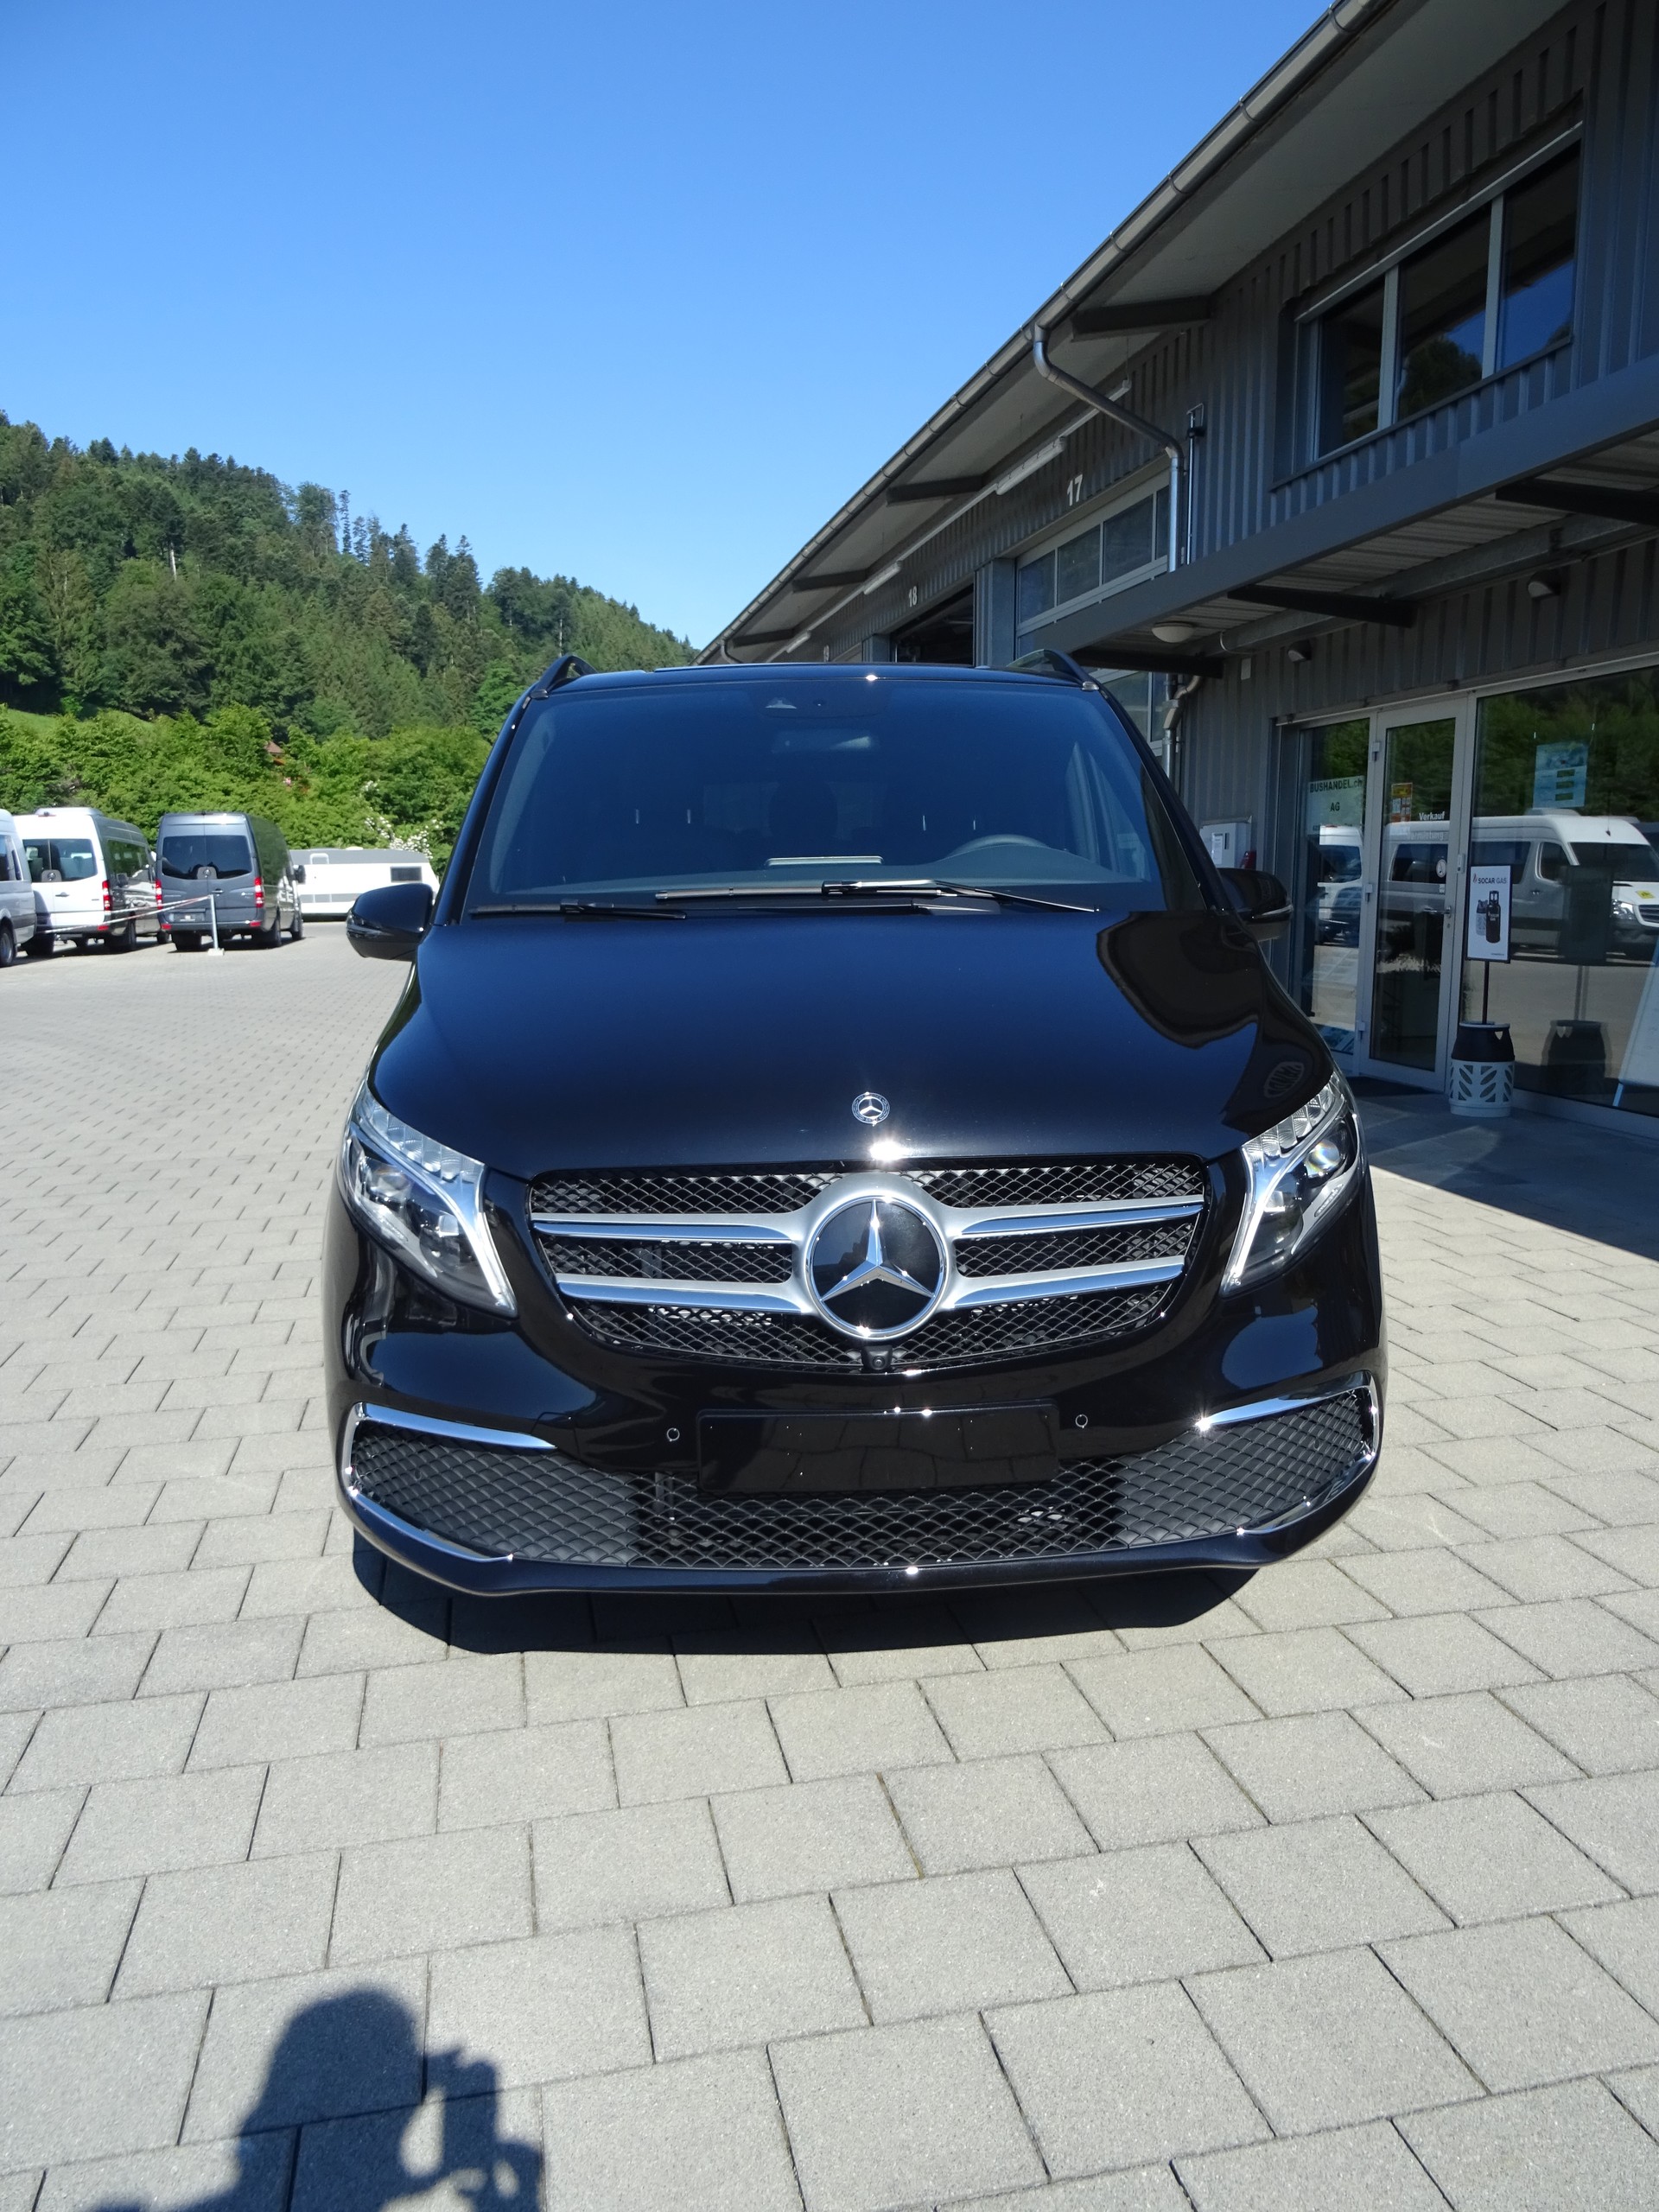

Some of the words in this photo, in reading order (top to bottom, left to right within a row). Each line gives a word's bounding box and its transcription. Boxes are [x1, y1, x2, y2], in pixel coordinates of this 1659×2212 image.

[1067, 474, 1083, 506] 17
[909, 586, 917, 607] 18
[1310, 779, 1363, 792] BUSHANDEL.ch
[1331, 802, 1340, 811] AG
[1419, 811, 1445, 820] Verkauf
